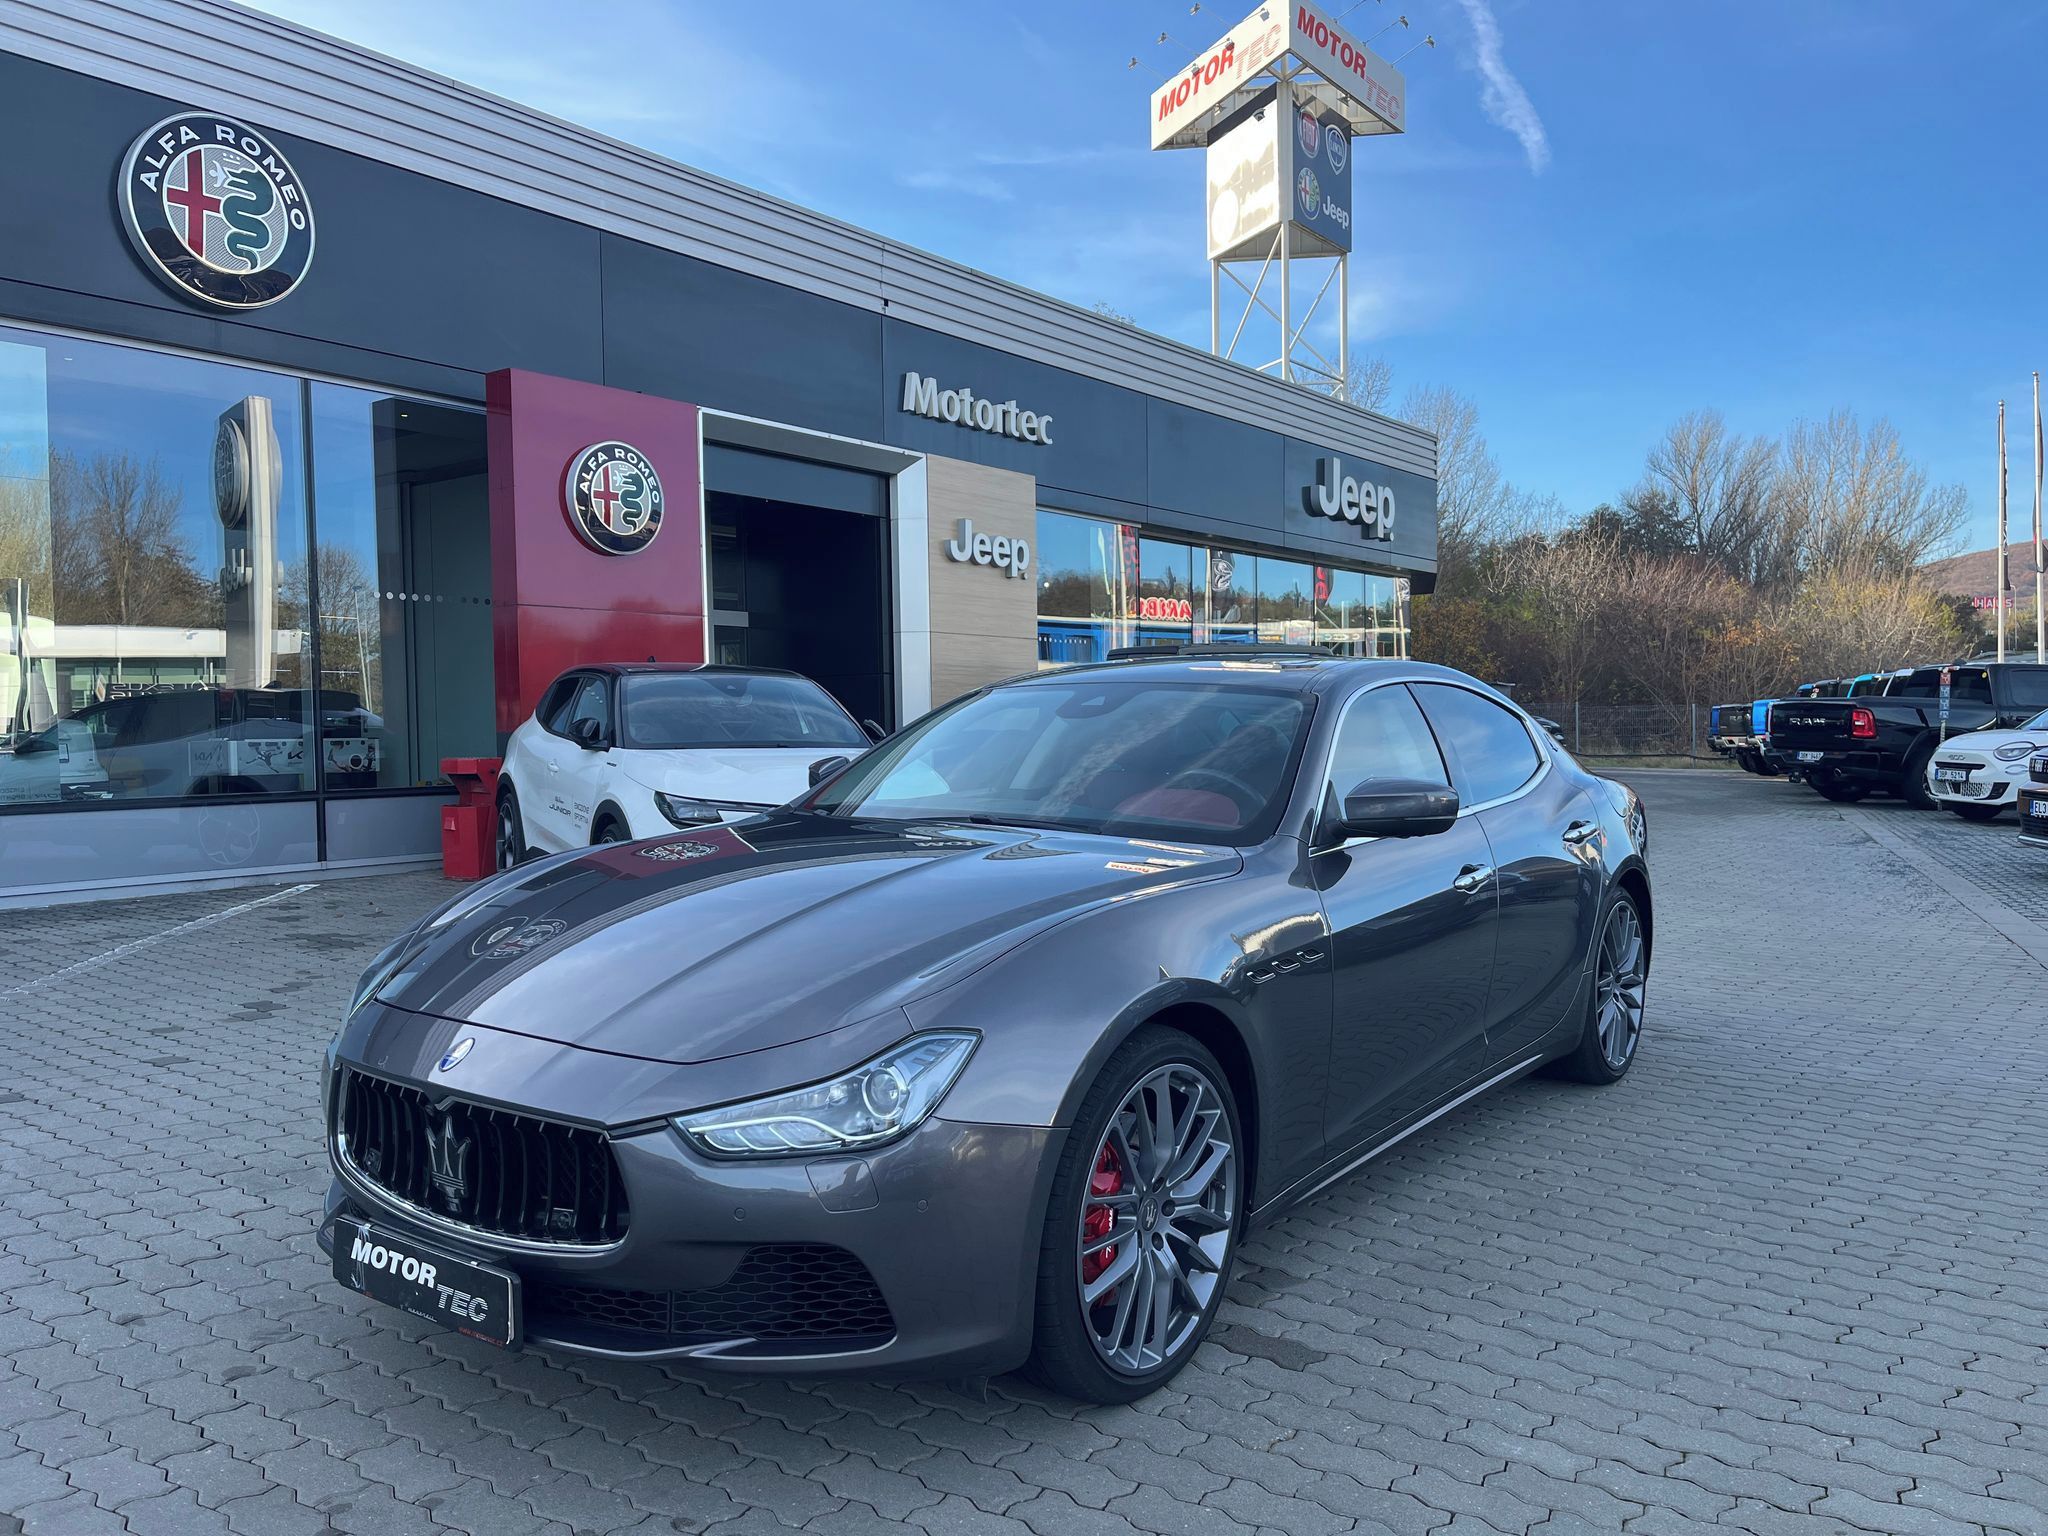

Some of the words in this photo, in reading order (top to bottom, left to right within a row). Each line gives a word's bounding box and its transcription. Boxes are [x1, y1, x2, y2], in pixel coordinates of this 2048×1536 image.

[1159, 42, 1235, 122] MOTOR
[1235, 23, 1281, 80] TEC
[1297, 6, 1368, 80] MOTOR
[1365, 76, 1400, 120] TEC
[140, 125, 201, 193] ALFA
[214, 124, 306, 231] ROMEO
[1322, 195, 1350, 229] Jeep
[903, 371, 1053, 445] Motortec
[580, 452, 608, 494] ALFA
[614, 448, 660, 504] ROMEO
[1304, 457, 1396, 540] Jeep
[945, 518, 1030, 579] Jeep
[1977, 598, 2012, 609] HAS
[350, 1237, 437, 1289] MOTOR
[436, 1283, 489, 1322] TEC
